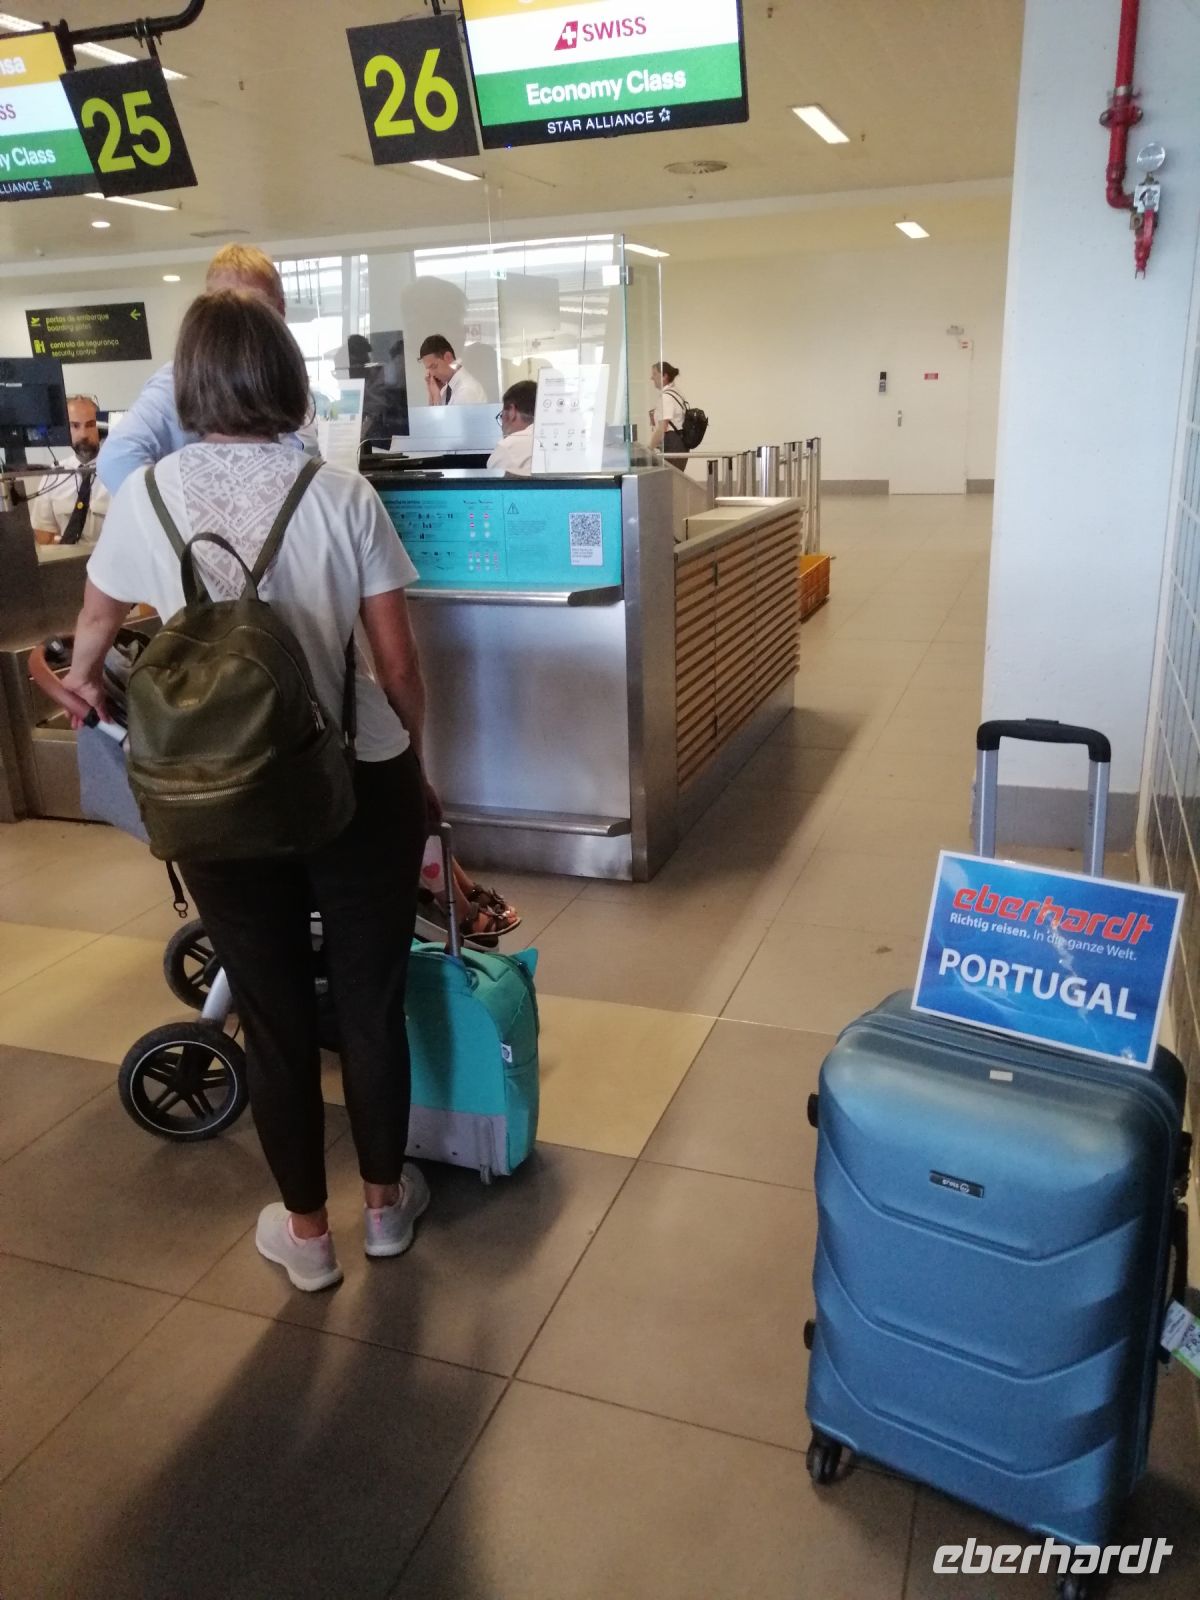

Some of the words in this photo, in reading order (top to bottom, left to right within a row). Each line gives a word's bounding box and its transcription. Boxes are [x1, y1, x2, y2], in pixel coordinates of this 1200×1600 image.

[582, 16, 647, 43] SWISS
[364, 48, 459, 138] 26
[525, 76, 623, 107] Economy
[626, 68, 687, 95] Class
[81, 90, 172, 173] 25
[547, 119, 584, 134] STAR
[586, 111, 655, 130] ALLIANCE
[11, 146, 57, 166] Class
[67, 314, 75, 322] de
[76, 339, 85, 348] de
[953, 884, 1153, 945] eberhardt
[950, 911, 989, 933] Richtig
[991, 922, 1030, 939] reisen.
[1032, 929, 1044, 942] In
[1068, 937, 1104, 955] ganze
[1105, 944, 1137, 961] Welt.
[938, 947, 1137, 1021] PORTUGAL
